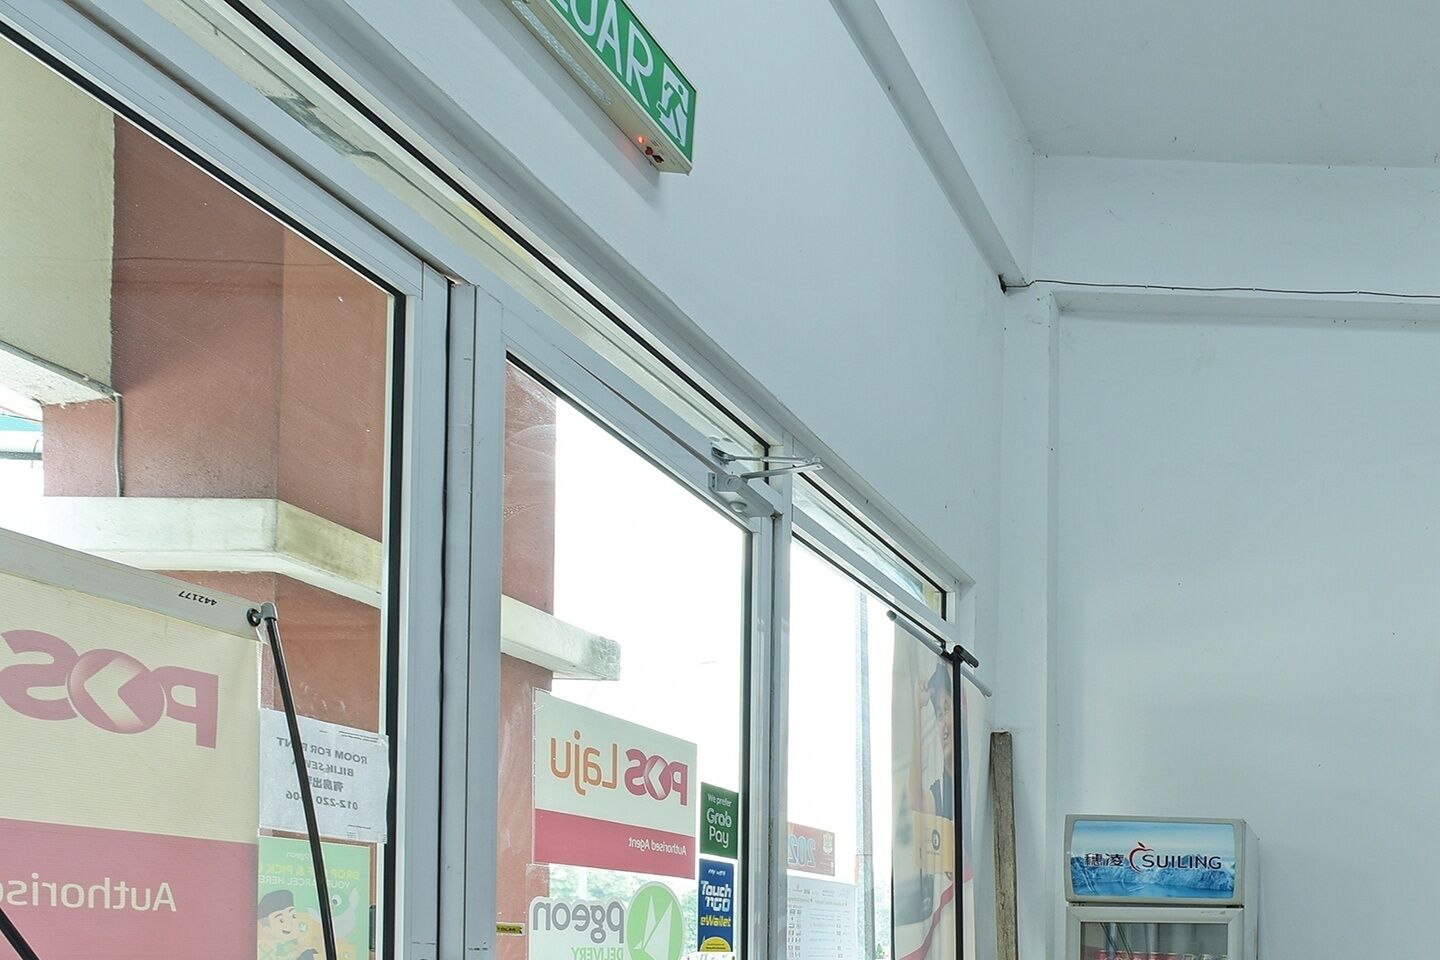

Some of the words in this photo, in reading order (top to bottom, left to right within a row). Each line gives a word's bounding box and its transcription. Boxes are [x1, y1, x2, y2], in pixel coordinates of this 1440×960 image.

[555, 0, 654, 108] UAR
[706, 808, 732, 828] Grab
[709, 826, 729, 848] Pay
[1142, 854, 1222, 870] SUILING
[700, 880, 732, 897] Touch
[700, 915, 731, 928] eWallet
